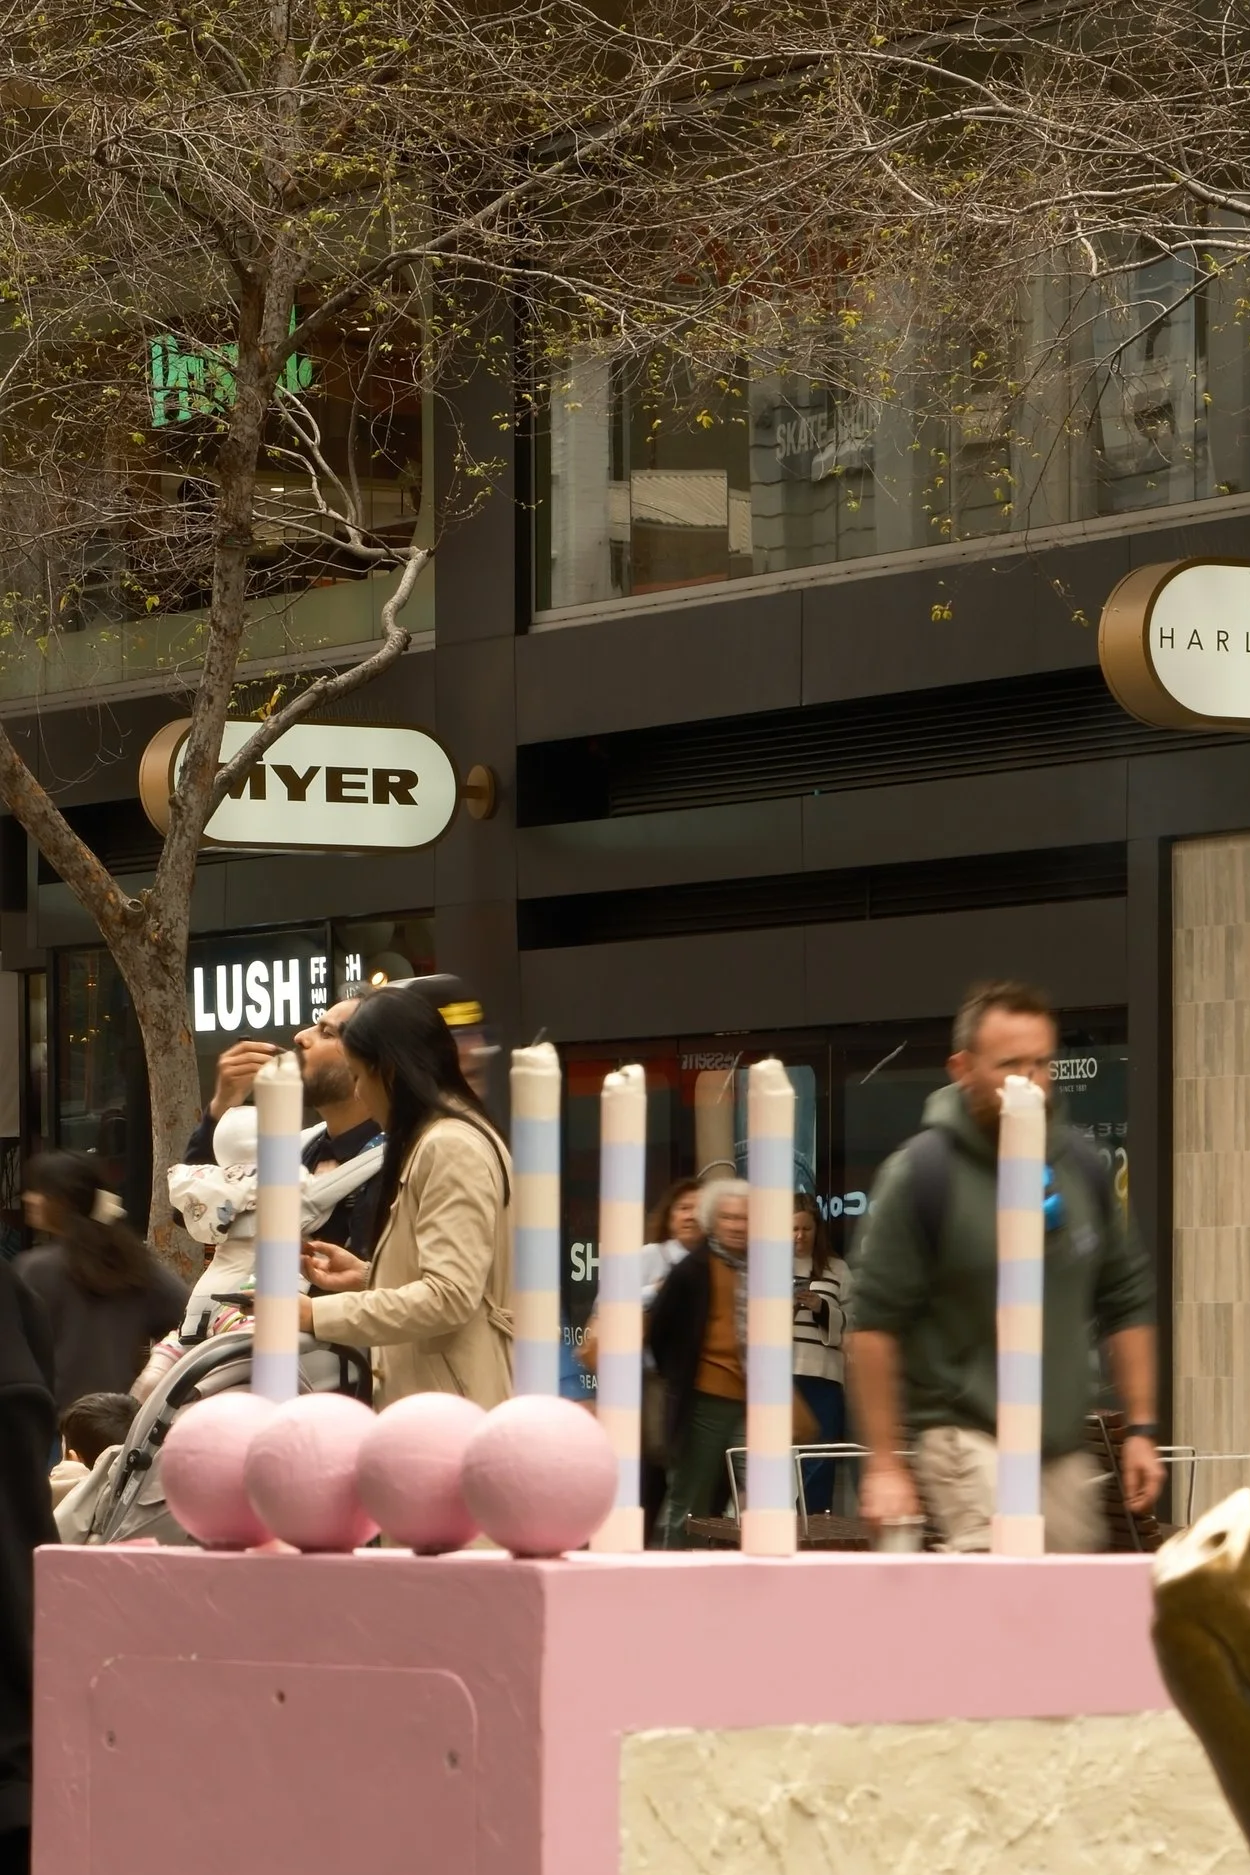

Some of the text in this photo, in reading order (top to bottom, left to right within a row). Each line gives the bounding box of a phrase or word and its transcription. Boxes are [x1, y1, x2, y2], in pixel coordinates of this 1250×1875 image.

[776, 412, 827, 459] SKATE
[193, 958, 300, 1032] LUSH
[1048, 1057, 1098, 1080] SEIKO
